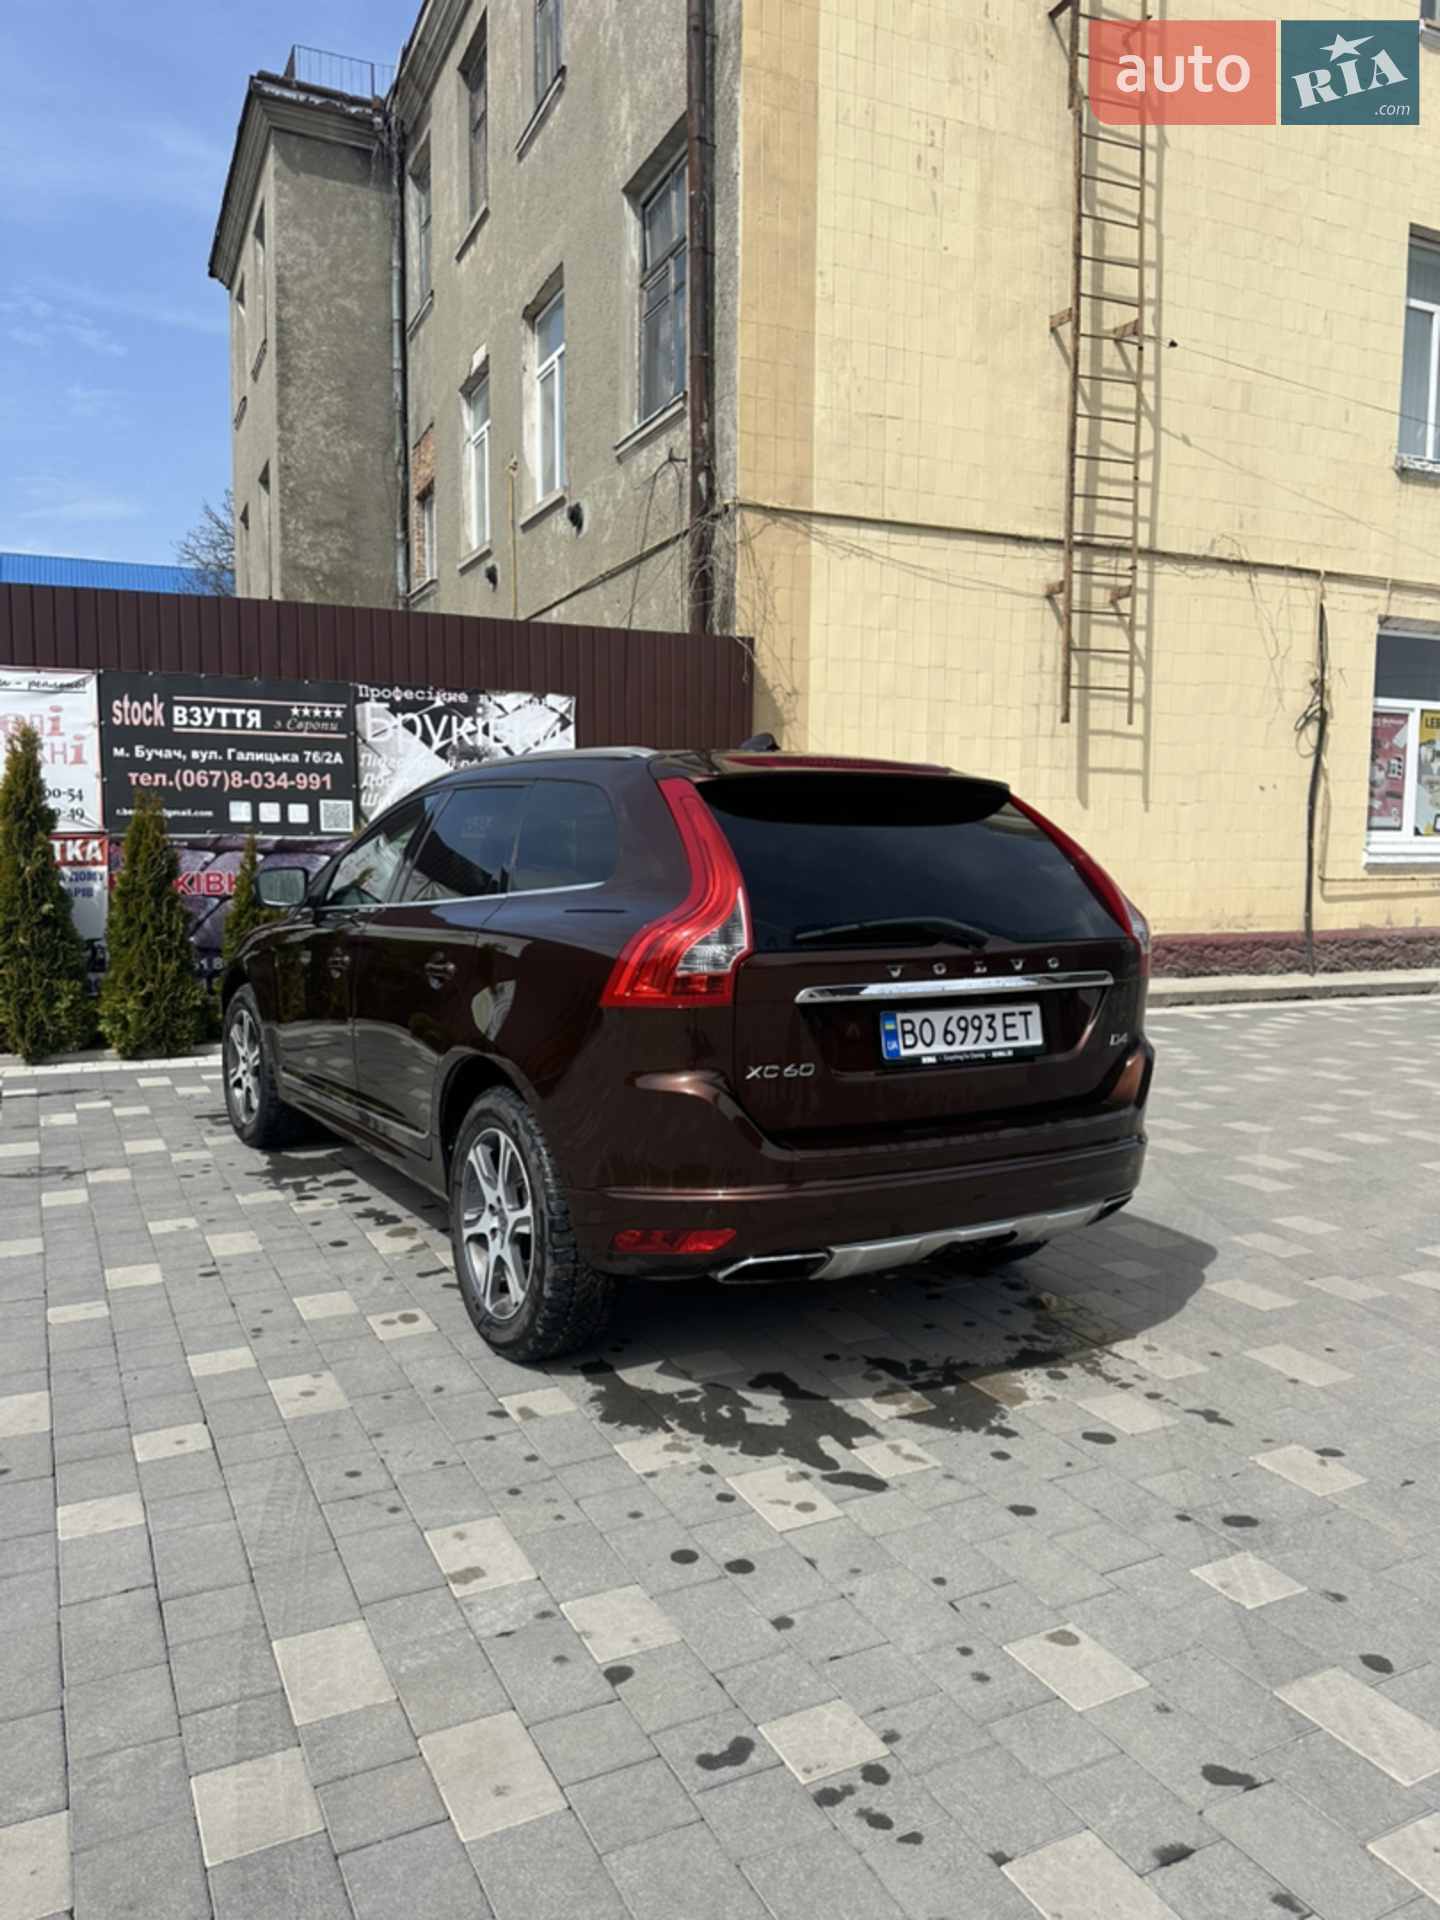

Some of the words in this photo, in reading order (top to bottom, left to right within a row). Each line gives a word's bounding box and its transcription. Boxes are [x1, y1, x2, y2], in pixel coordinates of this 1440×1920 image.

[112, 692, 165, 727] stock
[172, 705, 262, 730] ВЗУТТЯ
[113, 747, 130, 759] м.
[134, 744, 187, 762] Бучач,
[191, 750, 223, 763] вул.
[226, 747, 300, 764] Галицька
[887, 956, 1060, 979] VOLVO
[900, 1018, 937, 1050] BO
[942, 1012, 998, 1048] 6993
[1001, 1010, 1033, 1043] ET
[745, 1062, 816, 1080] XC60
